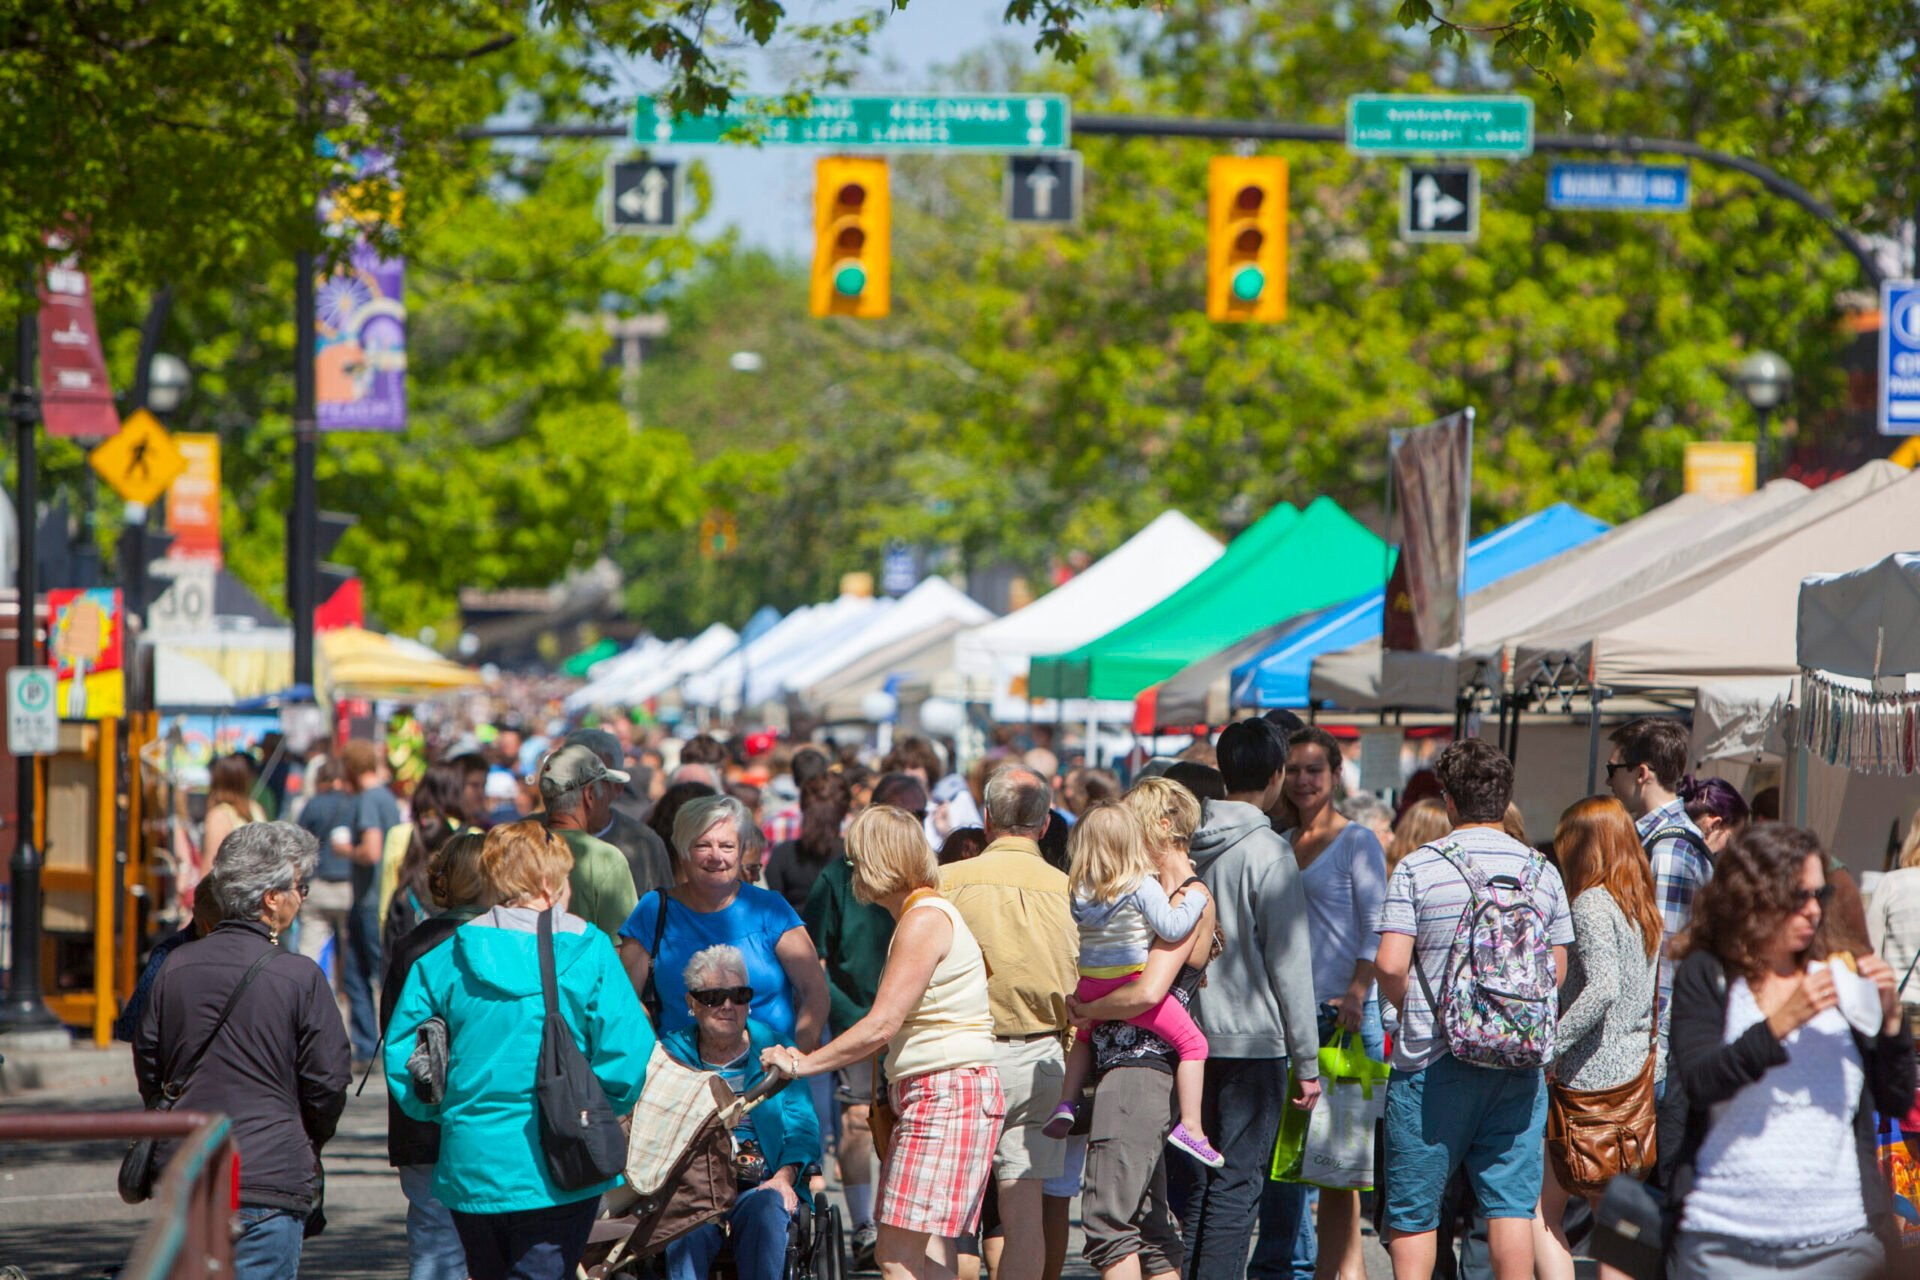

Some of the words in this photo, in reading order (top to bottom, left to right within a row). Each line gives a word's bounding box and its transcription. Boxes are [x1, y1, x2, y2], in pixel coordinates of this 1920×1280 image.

[889, 100, 1010, 121] KELOWNA
[803, 120, 858, 138] LEFT
[872, 120, 949, 141] LANES
